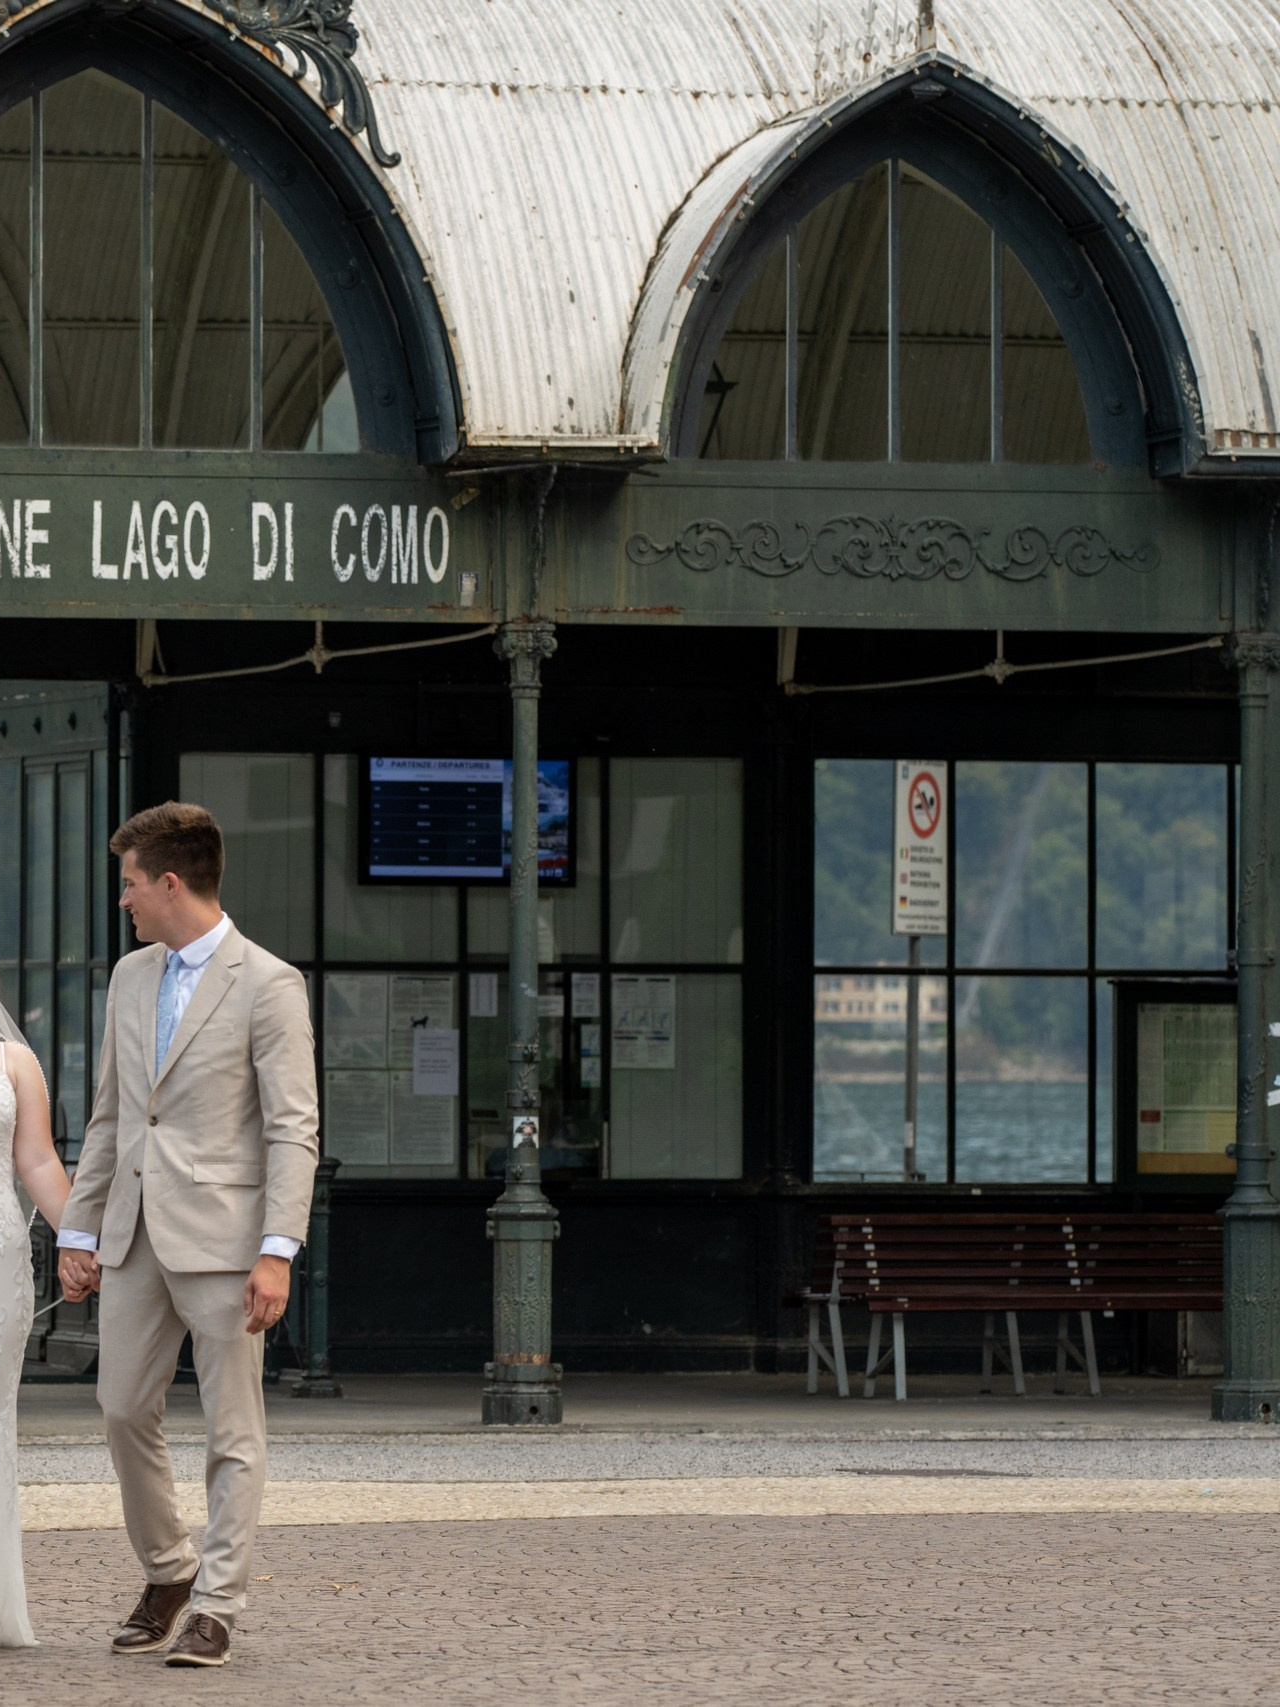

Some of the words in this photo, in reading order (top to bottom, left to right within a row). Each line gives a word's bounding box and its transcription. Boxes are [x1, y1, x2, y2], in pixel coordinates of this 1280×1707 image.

[90, 498, 211, 582] LAGO
[251, 500, 296, 583] DI
[330, 502, 451, 585] COMO
[390, 760, 431, 769] PARTENZE
[437, 761, 490, 770] DEPARTURES
